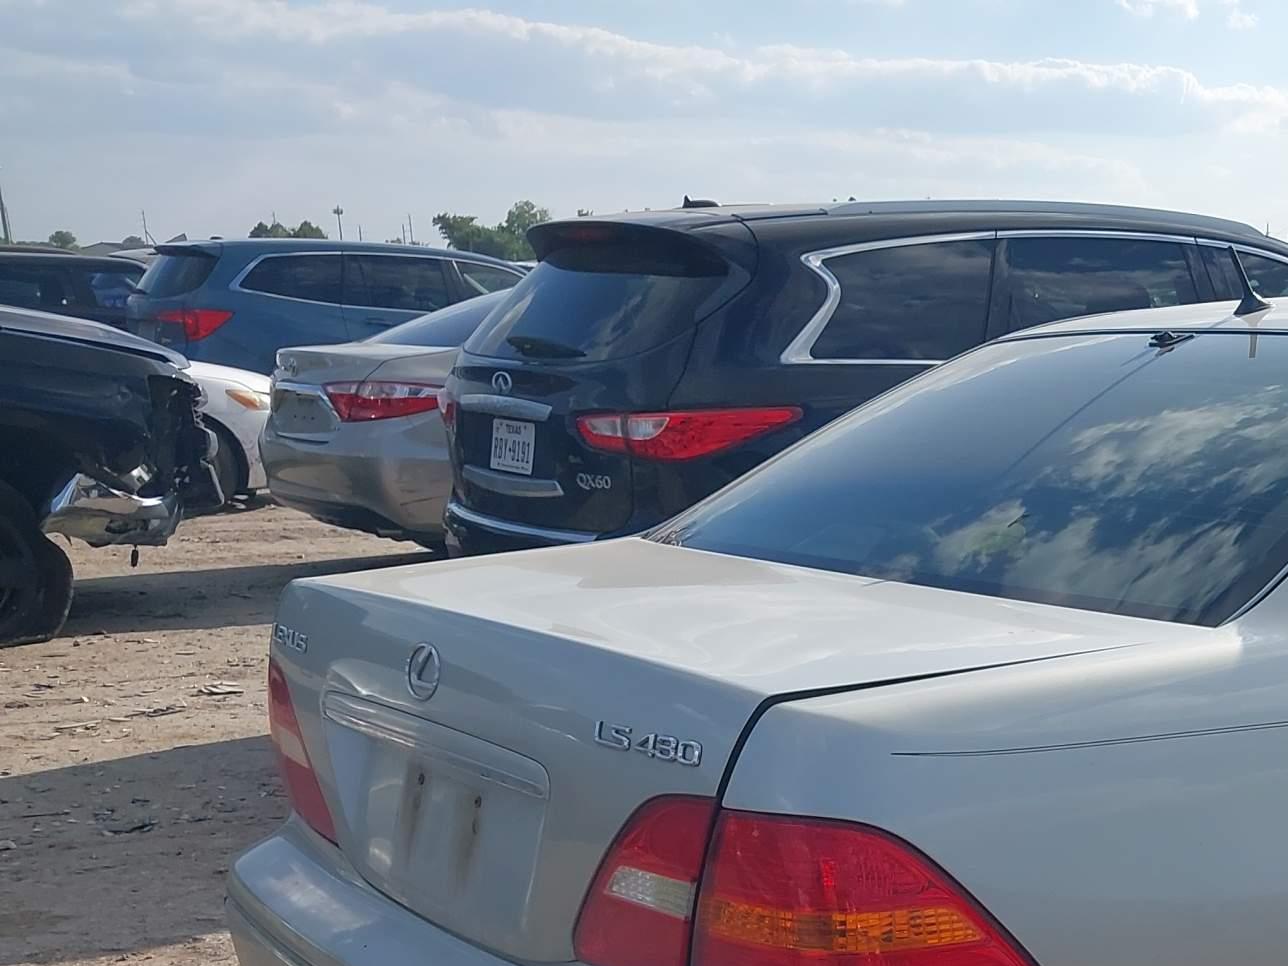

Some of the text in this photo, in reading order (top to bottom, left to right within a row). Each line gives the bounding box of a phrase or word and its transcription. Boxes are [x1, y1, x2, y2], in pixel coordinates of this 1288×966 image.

[505, 423, 522, 435] TEXAS
[576, 472, 612, 490] QX60
[594, 719, 703, 767] LS 430
